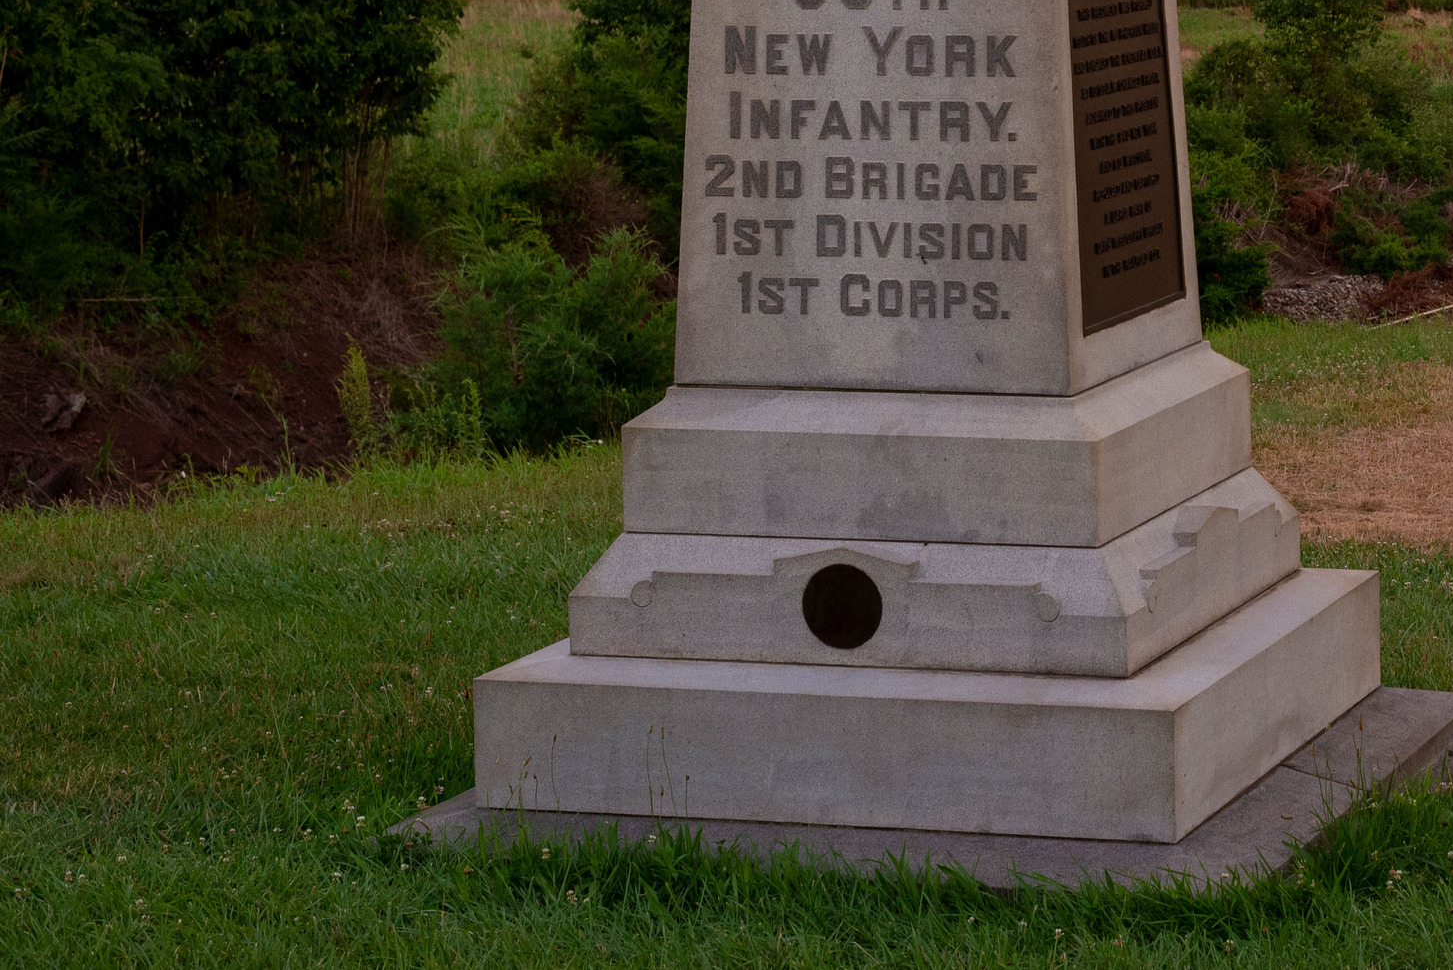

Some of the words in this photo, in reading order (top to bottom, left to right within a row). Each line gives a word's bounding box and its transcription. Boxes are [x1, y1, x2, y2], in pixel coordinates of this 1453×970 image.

[724, 25, 833, 76] NEW
[862, 26, 1018, 77] YORK
[729, 91, 1018, 142] INFANTRY.
[704, 154, 803, 198] 2ND
[824, 156, 1038, 201] BRIGADE
[712, 212, 795, 256] 1ST
[816, 214, 1028, 261] DIVISION
[737, 271, 820, 315] 1ST
[840, 273, 1010, 320] CORPS.
